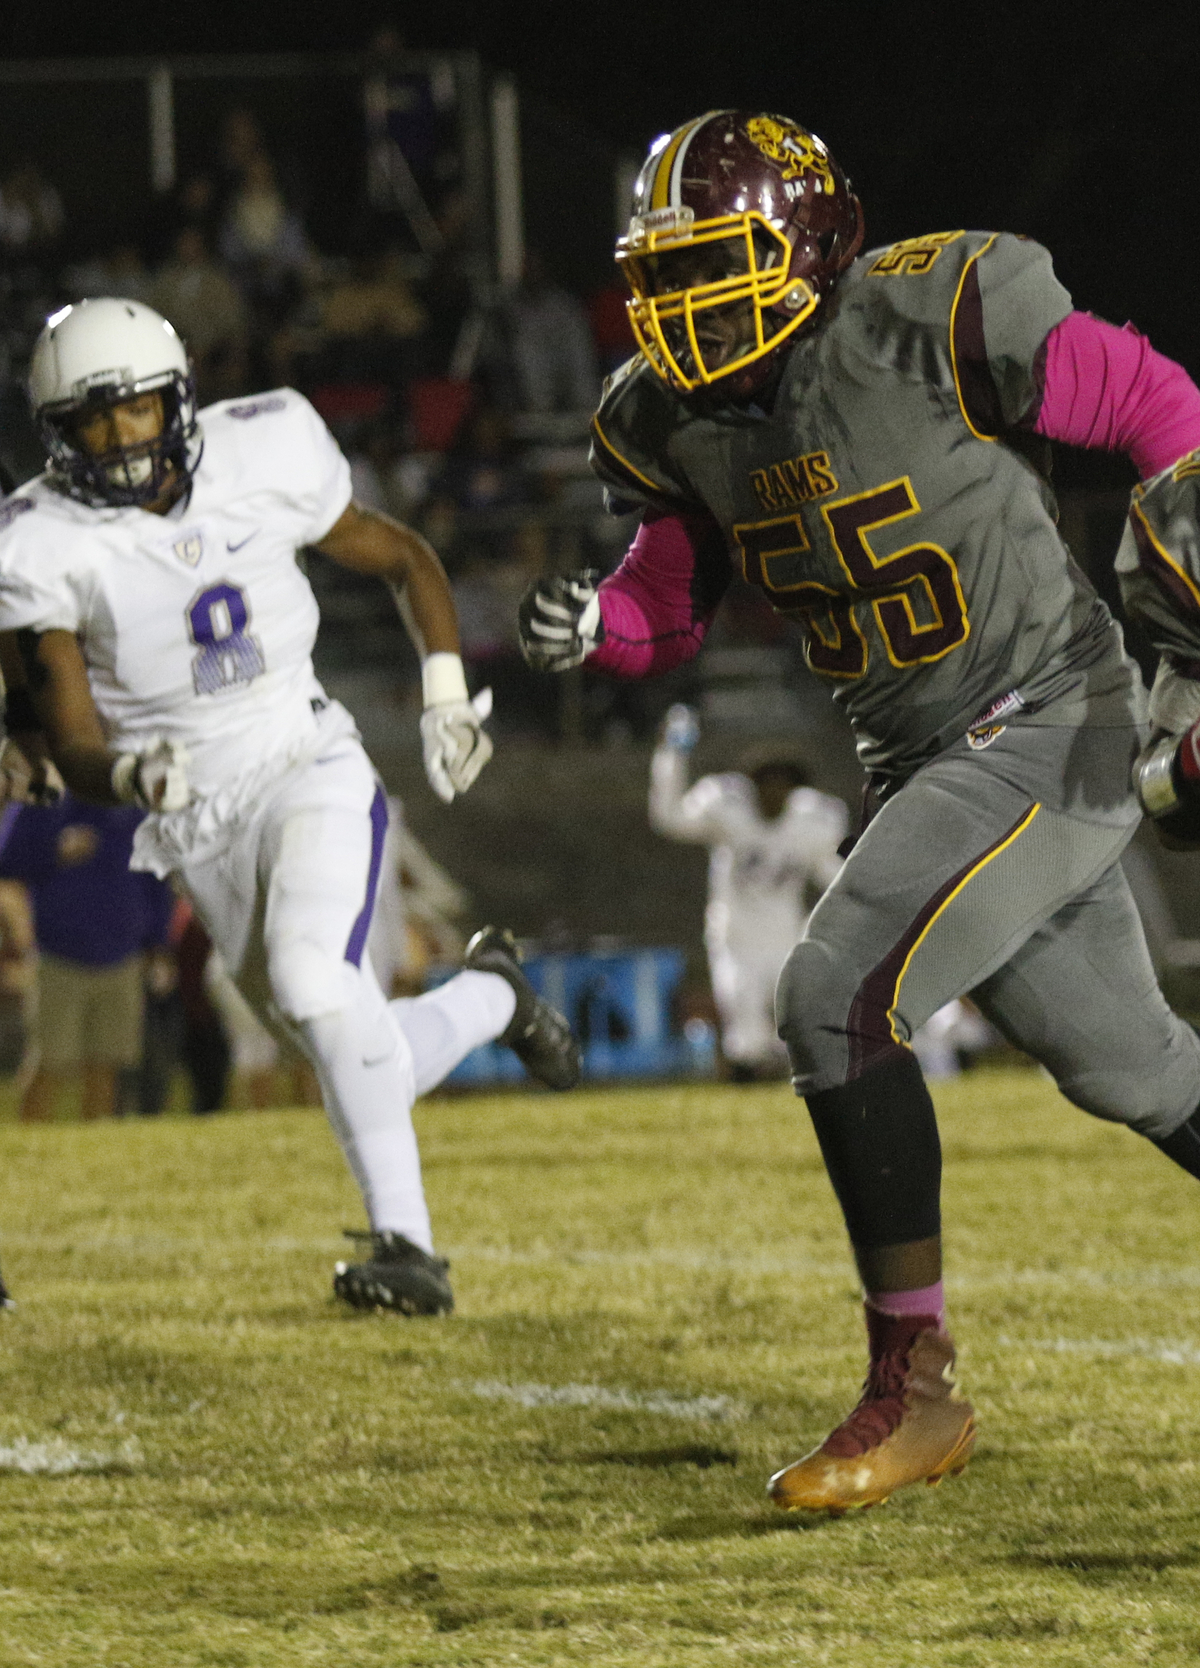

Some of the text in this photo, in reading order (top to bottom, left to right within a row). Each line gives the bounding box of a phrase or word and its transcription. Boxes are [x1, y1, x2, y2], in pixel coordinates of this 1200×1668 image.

[750, 450, 839, 512] RAMS
[184, 577, 267, 697] 8
[733, 475, 970, 679] 55
